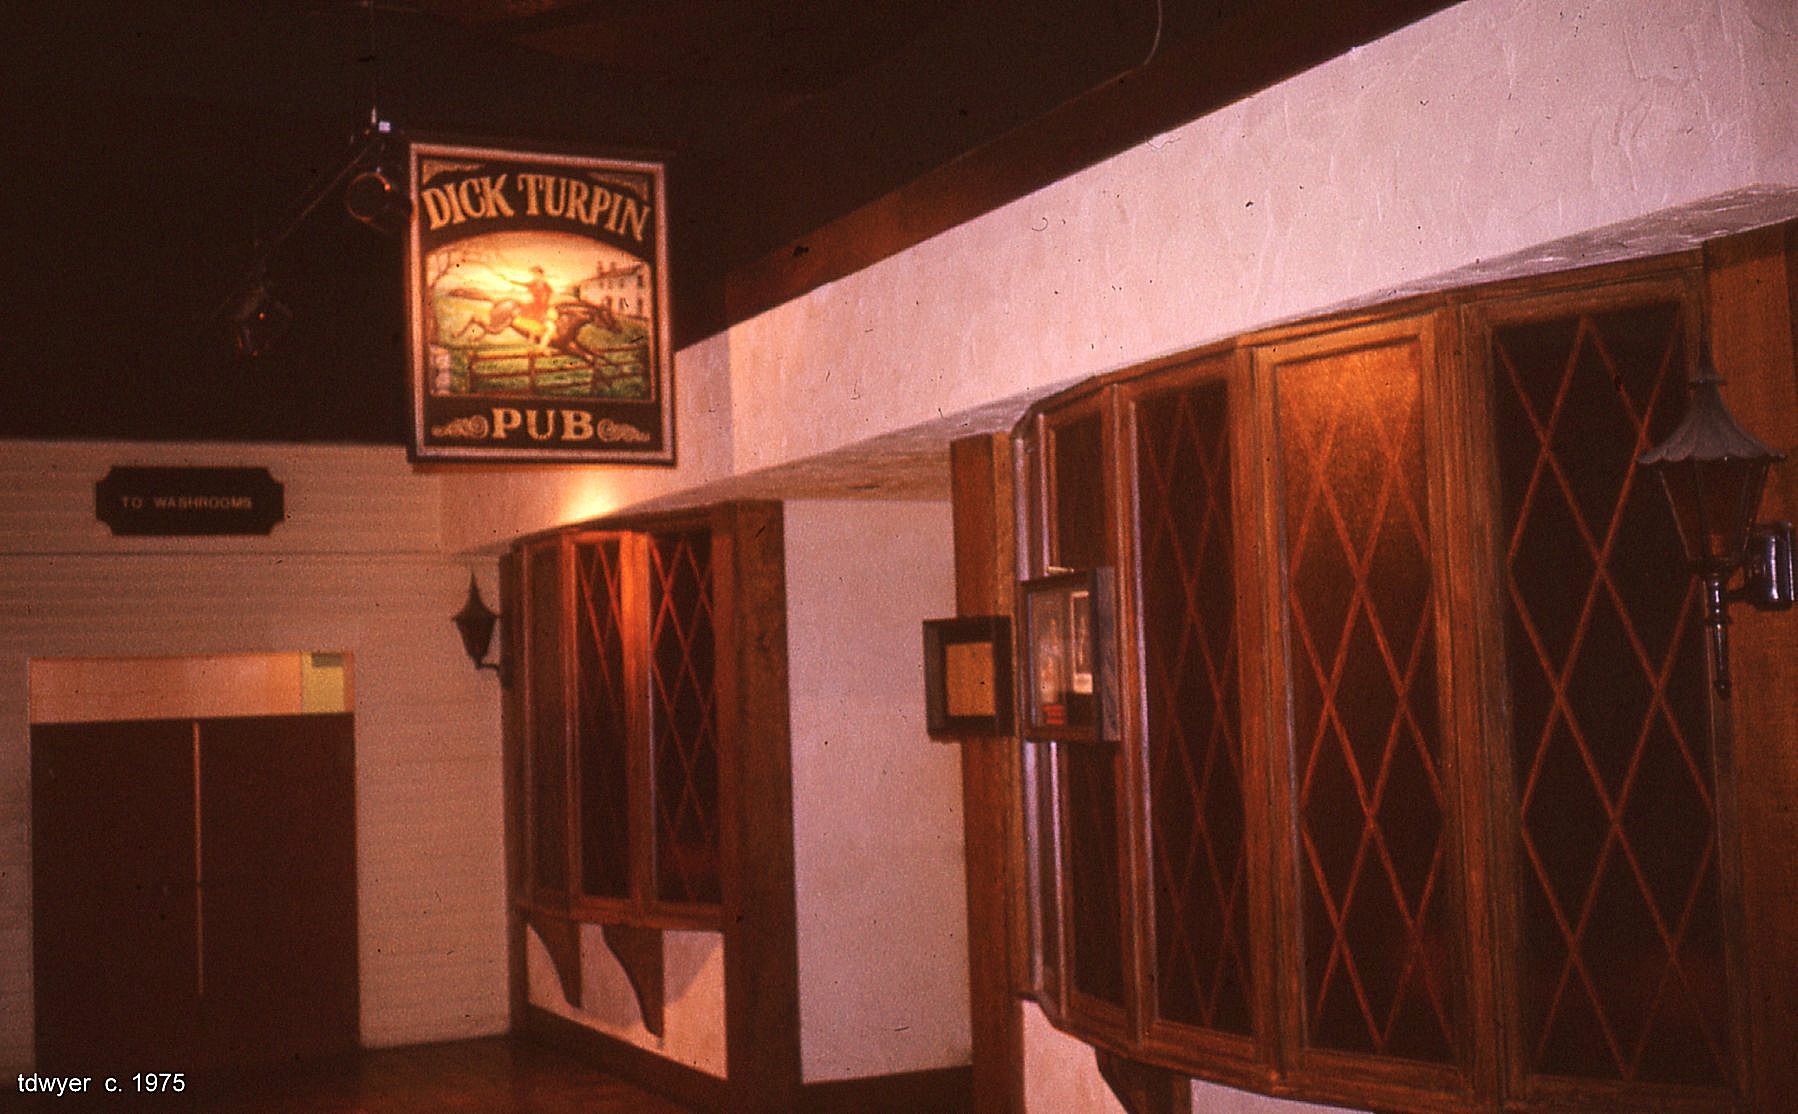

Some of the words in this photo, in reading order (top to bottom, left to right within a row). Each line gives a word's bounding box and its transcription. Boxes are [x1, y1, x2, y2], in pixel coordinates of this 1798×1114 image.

[421, 173, 514, 231] DICK
[517, 173, 651, 242] TURPIN
[490, 407, 595, 441] PUB
[122, 496, 143, 509] TO
